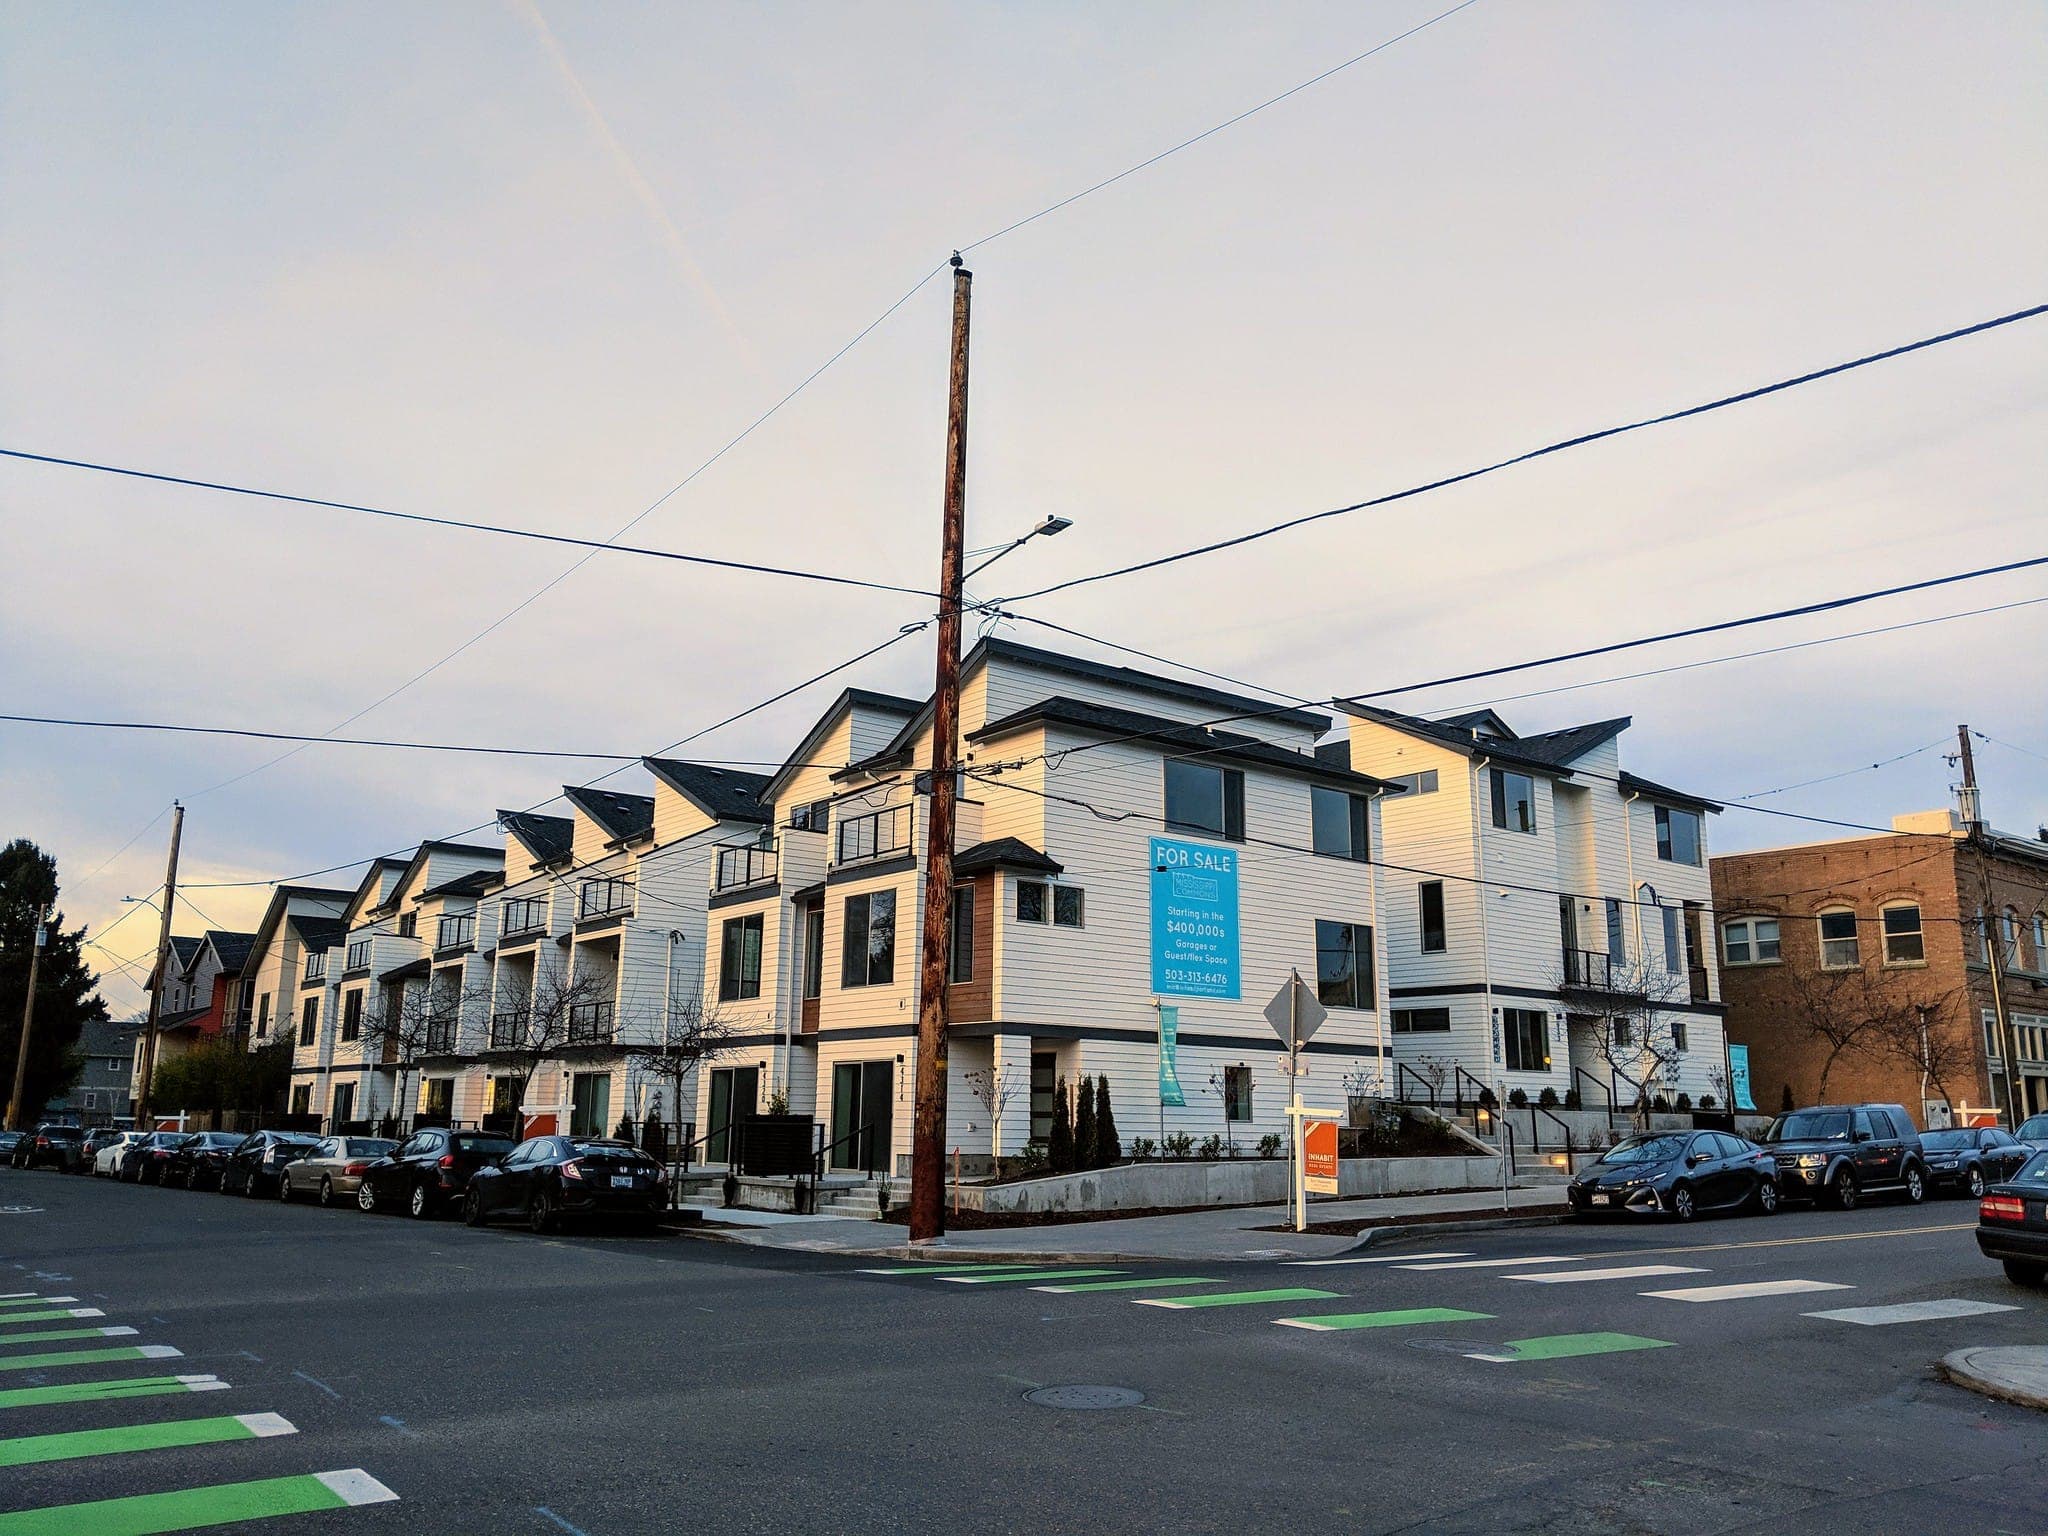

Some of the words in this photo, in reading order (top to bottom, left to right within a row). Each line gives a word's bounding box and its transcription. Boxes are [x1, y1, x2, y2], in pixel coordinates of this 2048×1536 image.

[1156, 846, 1188, 866] FOR
[1194, 852, 1230, 872] SALE
[1167, 905, 1200, 920] Starting
[1202, 910, 1210, 919] in
[1211, 911, 1225, 921] the
[1167, 919, 1225, 938] $400,000s
[1175, 939, 1208, 951] Garages
[1204, 954, 1228, 965] Space
[1165, 969, 1228, 984] 503-313-6476
[1308, 1153, 1334, 1162] INHABIT
